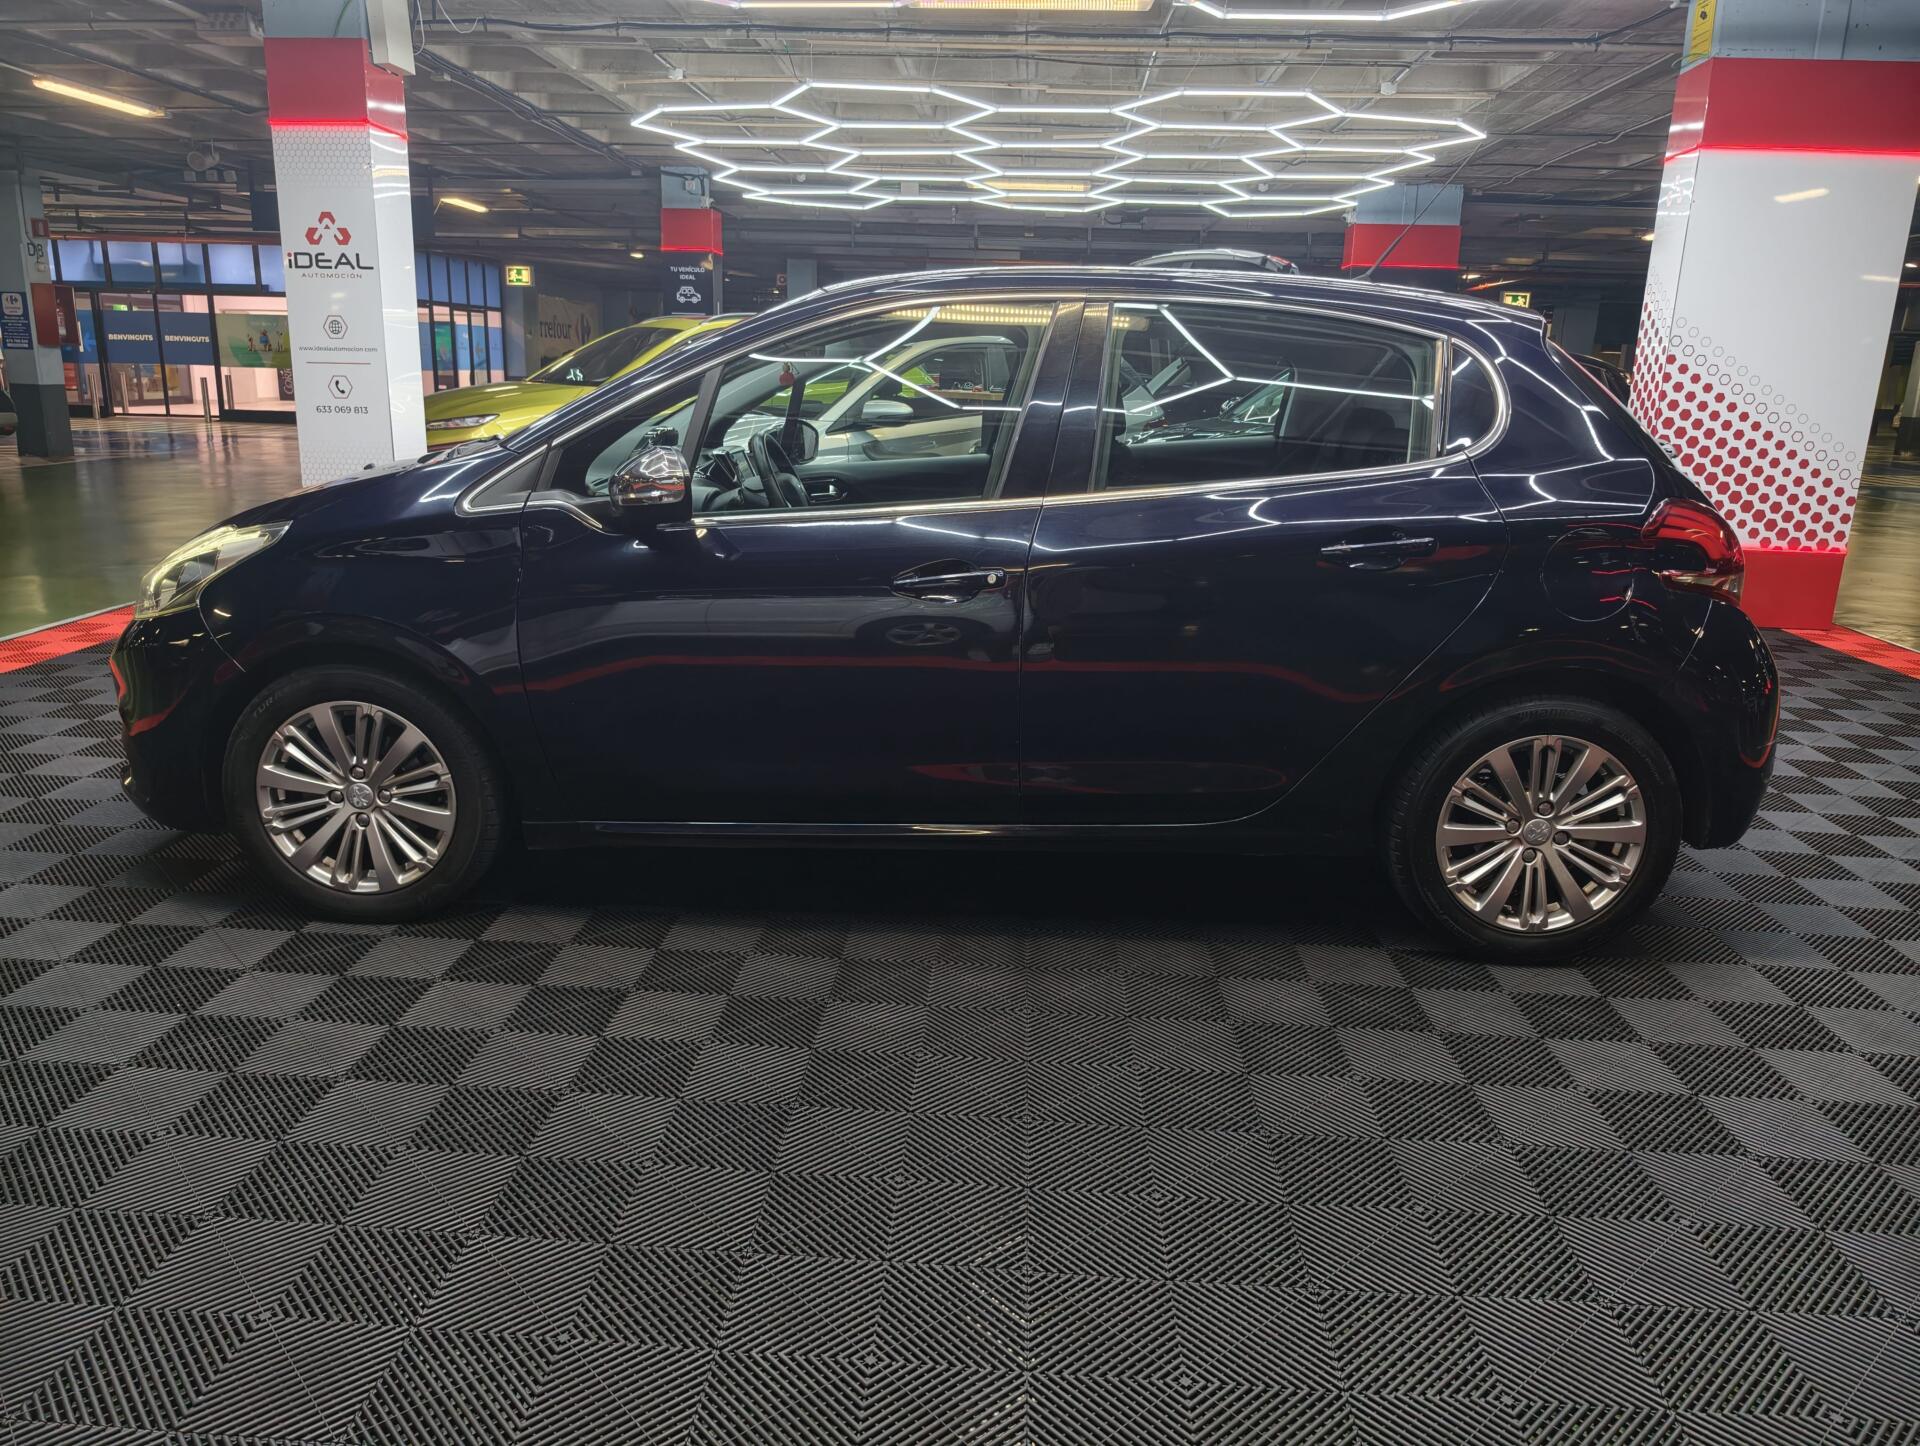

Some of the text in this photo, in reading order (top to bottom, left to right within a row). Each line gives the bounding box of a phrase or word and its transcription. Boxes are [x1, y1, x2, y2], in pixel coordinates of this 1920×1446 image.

[678, 265, 705, 273] VEHÍCULO
[108, 333, 154, 341] BENVINGUTS
[164, 335, 210, 343] BENVINGUTS
[316, 405, 369, 415] 633 069 813
